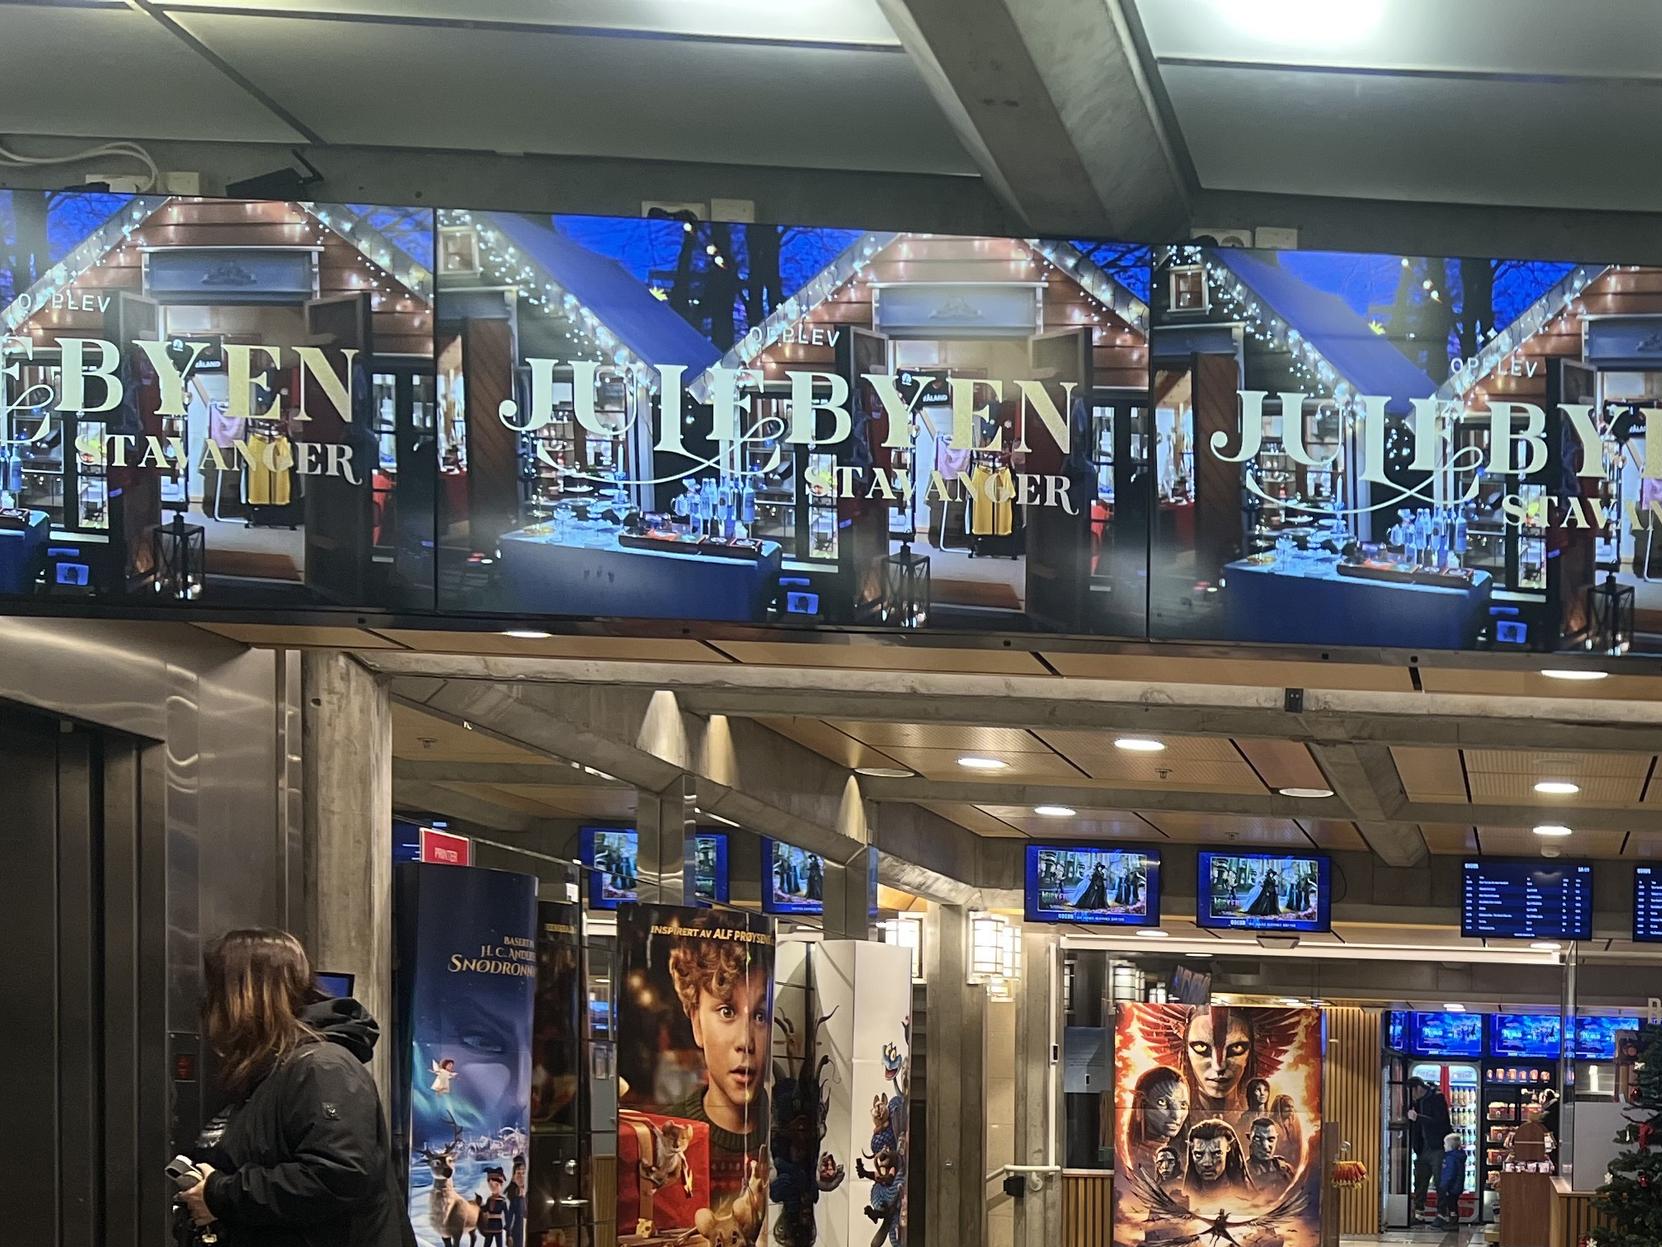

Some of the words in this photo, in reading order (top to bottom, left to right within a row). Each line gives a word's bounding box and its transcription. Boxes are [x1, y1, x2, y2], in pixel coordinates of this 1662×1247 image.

[0, 335, 359, 444] EBYEN
[498, 357, 1078, 484] JULEBYEN
[75, 433, 363, 485] STAVANGER
[805, 466, 1079, 515] STAVANGER
[650, 925, 699, 937] INSPIRERT
[700, 929, 712, 938] AV
[713, 928, 734, 940] ALF
